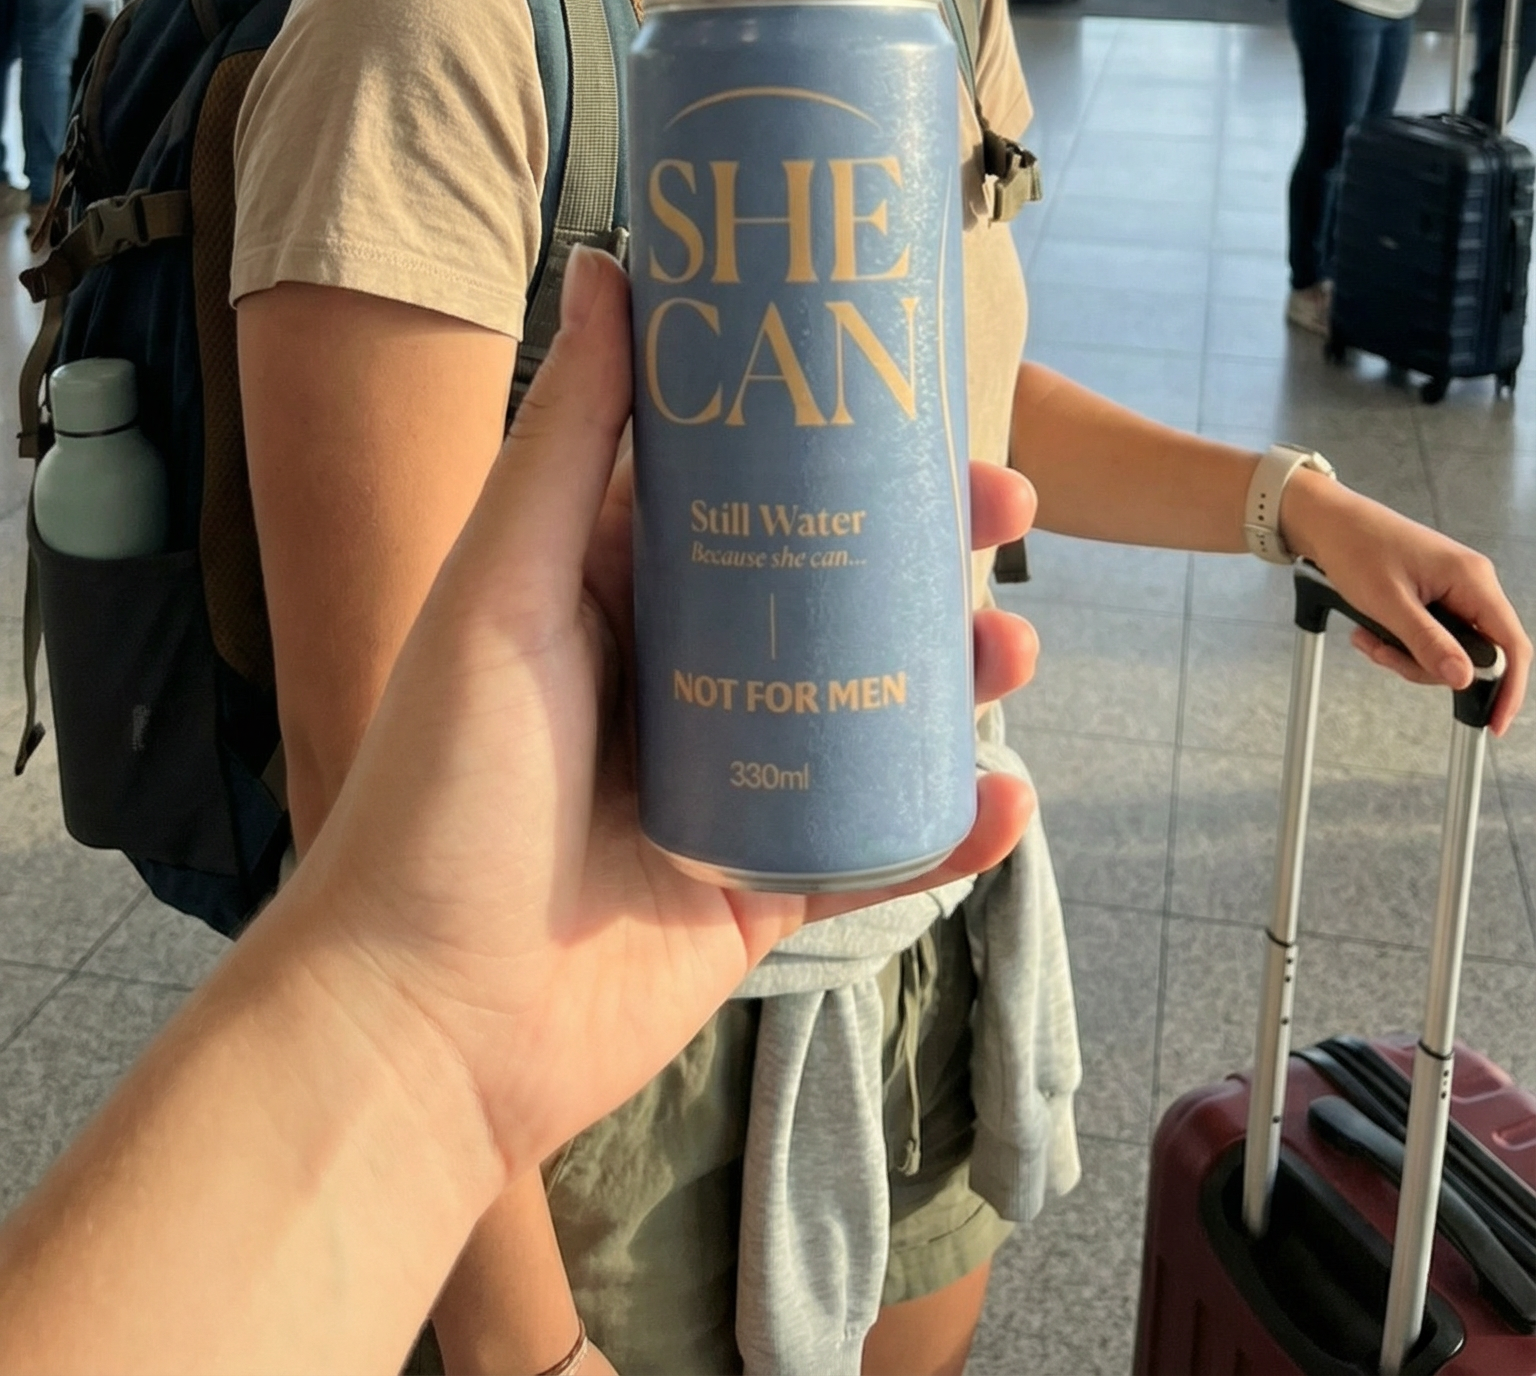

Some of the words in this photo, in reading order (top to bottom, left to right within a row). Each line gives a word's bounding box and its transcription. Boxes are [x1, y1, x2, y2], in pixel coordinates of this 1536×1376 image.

[648, 156, 911, 284] SHE
[646, 296, 920, 426] CAN
[691, 499, 750, 537] Still
[759, 503, 867, 538] Water
[691, 541, 768, 569] Because
[771, 545, 807, 569] she
[809, 550, 868, 569] can...
[674, 669, 739, 712] NOT
[747, 680, 820, 714] FOR
[828, 670, 907, 712] MEN
[729, 760, 810, 791] 330ml
